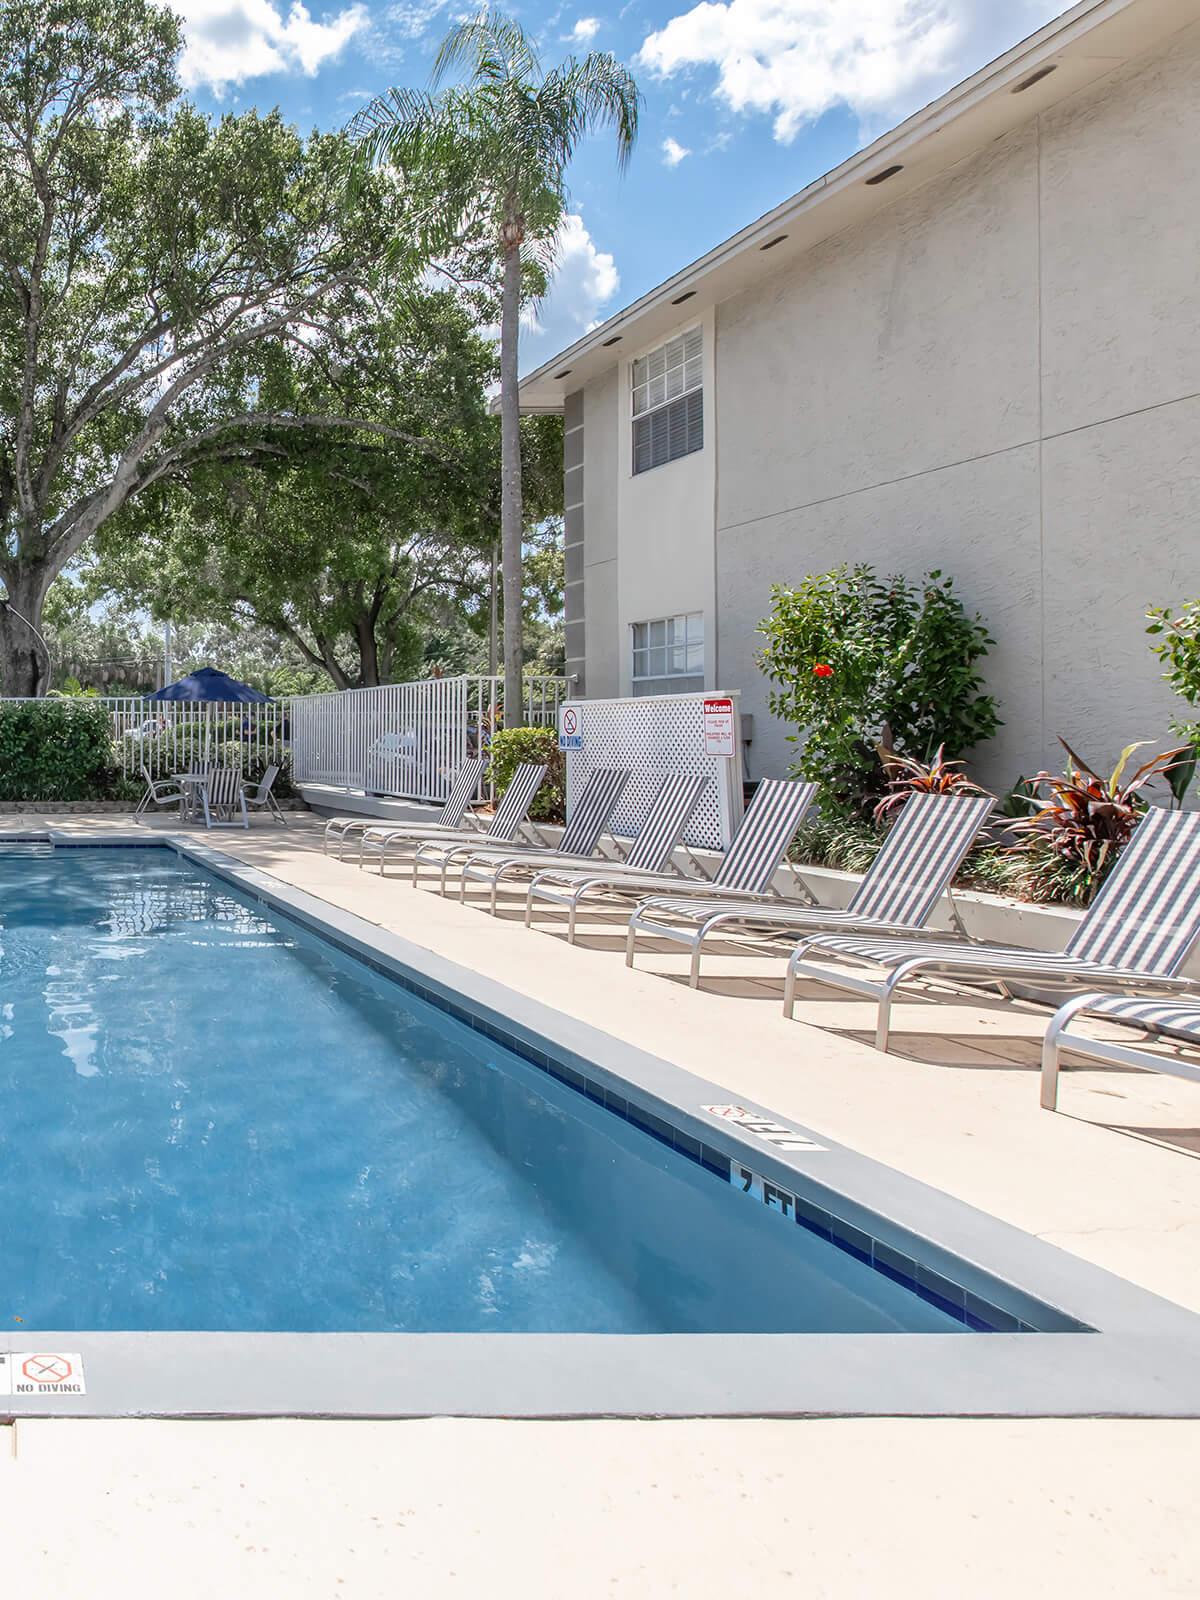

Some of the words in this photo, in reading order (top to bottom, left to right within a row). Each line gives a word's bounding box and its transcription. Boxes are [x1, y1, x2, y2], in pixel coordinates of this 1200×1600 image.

[704, 704, 731, 713] Welcome
[560, 735, 566, 747] NO
[567, 735, 582, 747] DIVING
[740, 1167, 752, 1192] 7
[763, 1182, 793, 1216] FT
[16, 1384, 33, 1393] NO
[38, 1384, 81, 1393] DIVING
